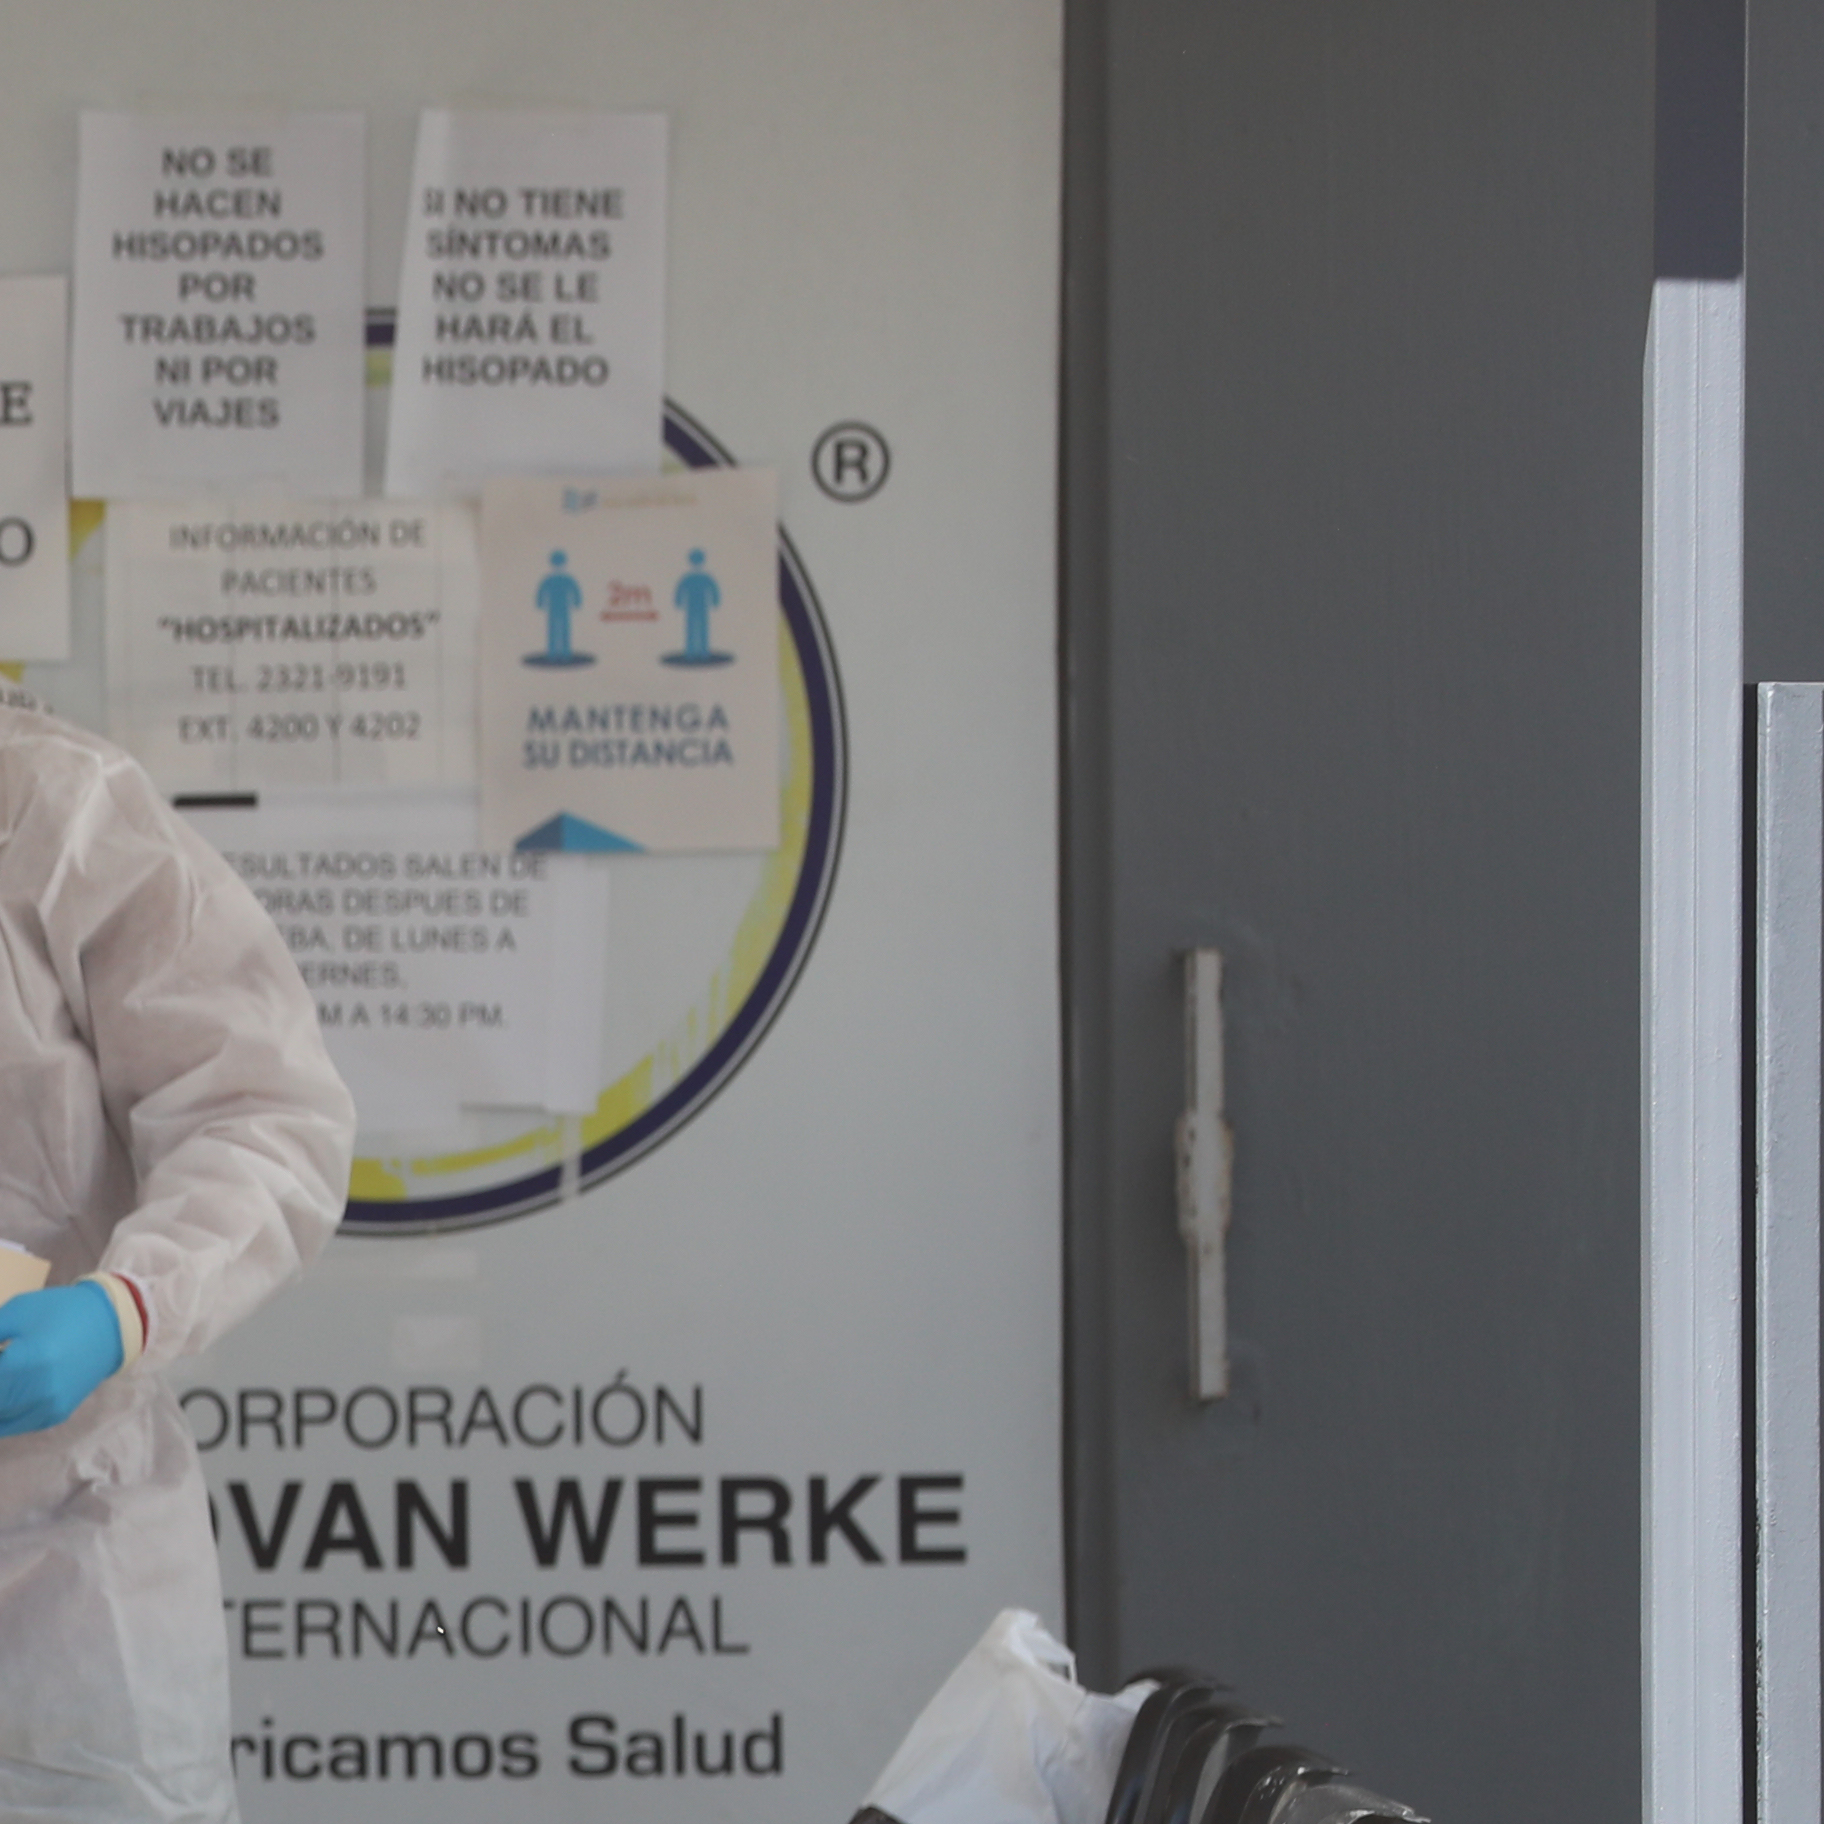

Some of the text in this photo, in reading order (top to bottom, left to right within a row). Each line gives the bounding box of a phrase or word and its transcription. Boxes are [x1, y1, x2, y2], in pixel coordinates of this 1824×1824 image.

[160, 148, 273, 178] NO SE
[153, 189, 282, 218] HACEN
[454, 187, 508, 219] NO
[520, 187, 625, 219] TIENE
[111, 230, 325, 261] HISOPADOS
[426, 223, 612, 261] SÍNTOMAS
[178, 272, 256, 303] POR
[432, 270, 600, 302] NO SE LE
[120, 313, 317, 345] TRABAJOS
[435, 307, 595, 345] HARÁ EL
[156, 355, 279, 386] NI POR
[422, 353, 610, 388] HISOPADO
[153, 397, 280, 429] VIAJES
[168, 518, 427, 552] INFORMACIÓN DE
[221, 566, 378, 598] PACIENTES
[245, 711, 320, 744] 4200
[324, 711, 344, 742] Y
[350, 709, 422, 742] 4202
[527, 702, 730, 733] MANTENGA
[523, 737, 734, 770] SU DISTANCIA
[220, 850, 550, 881] ESULTADOS SALEN DE
[253, 886, 336, 917] ORAS
[490, 886, 530, 917] DE
[341, 922, 383, 953] DE
[389, 922, 489, 953] LUNES
[494, 923, 519, 953] A
[348, 1001, 372, 1029] A
[179, 1366, 704, 1451] ORPORACIÓN
[208, 1472, 969, 1572] VAN WERKE
[230, 1711, 784, 1781] ricamos Salud
